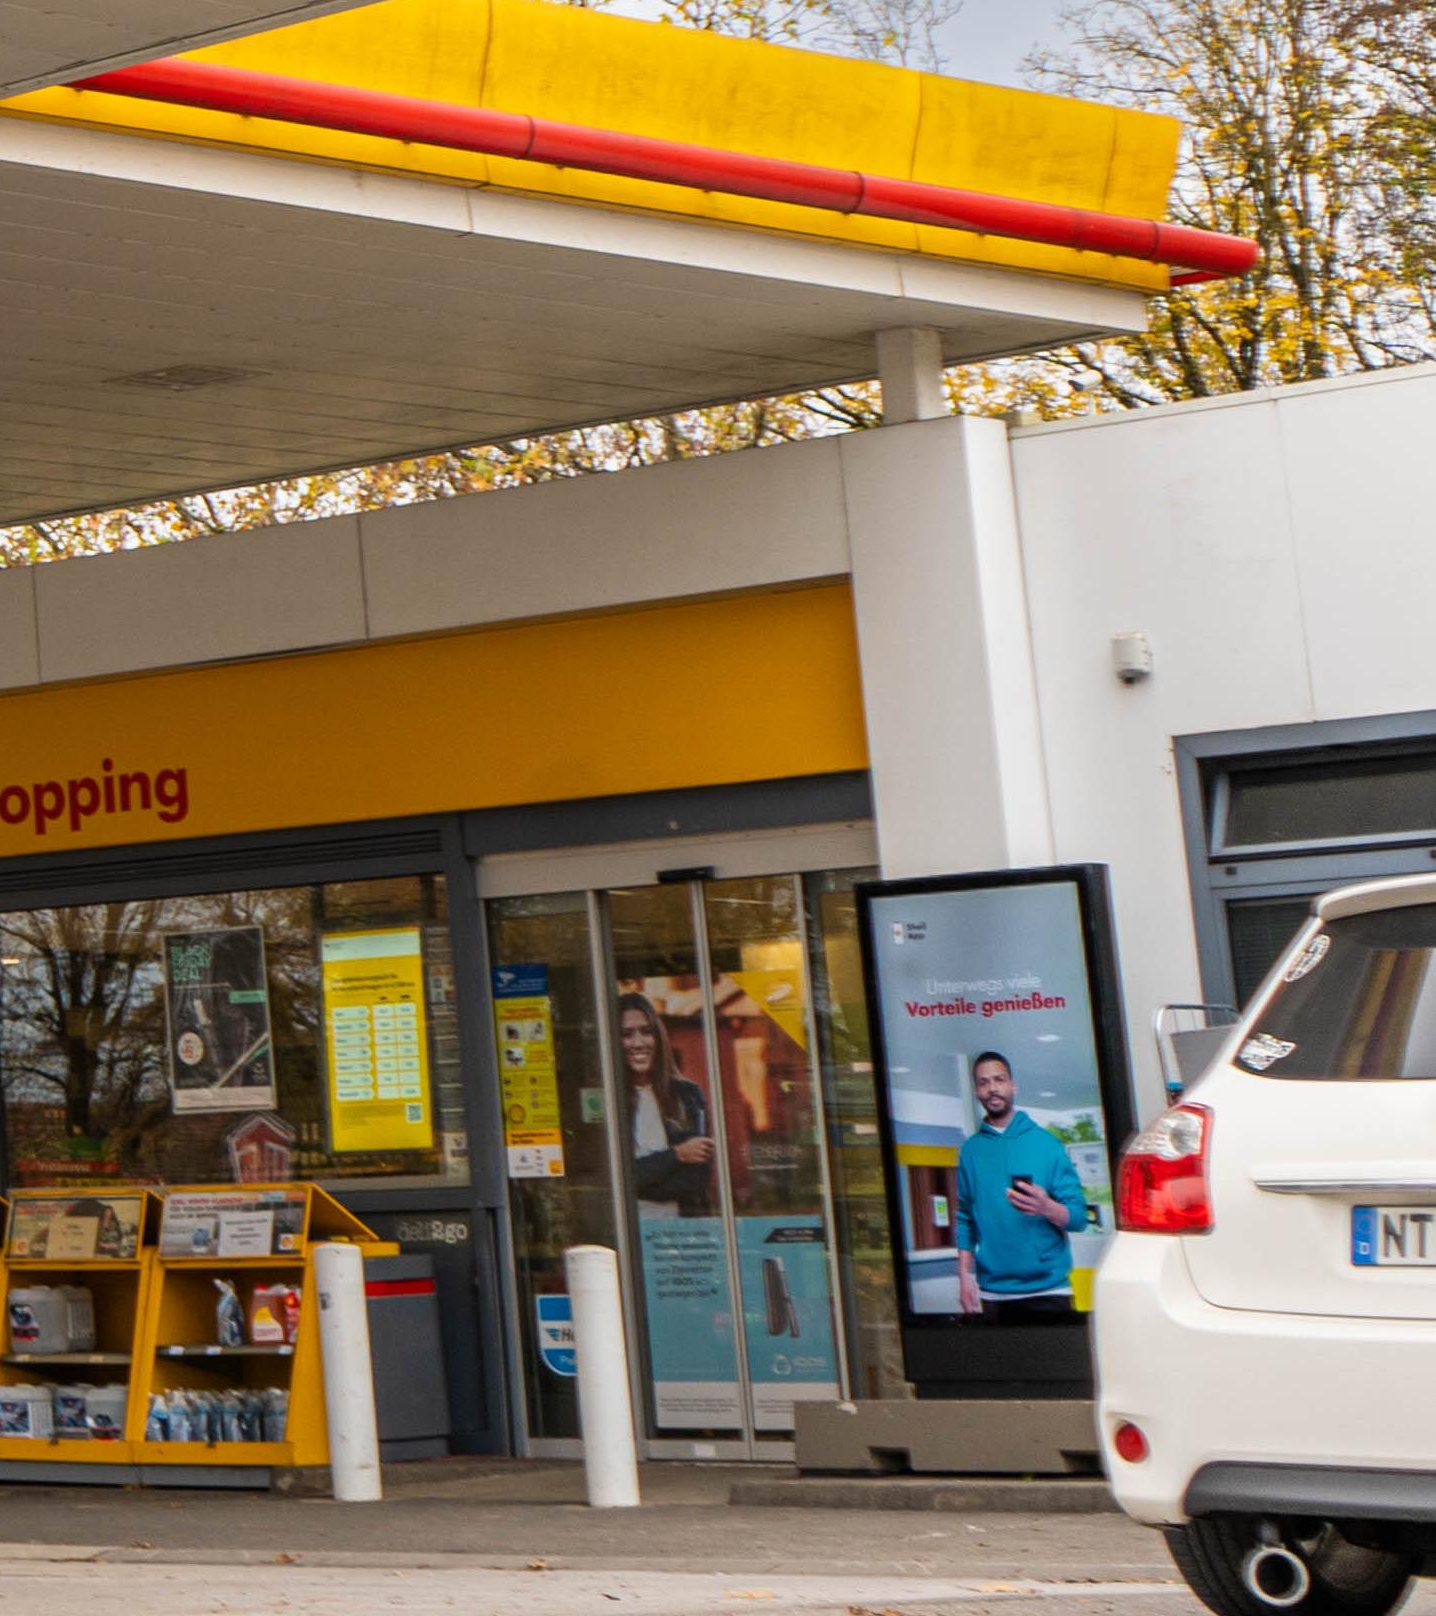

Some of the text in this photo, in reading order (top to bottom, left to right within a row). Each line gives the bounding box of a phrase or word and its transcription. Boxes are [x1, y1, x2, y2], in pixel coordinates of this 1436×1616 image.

[925, 970, 1042, 996] Unterwegs viele
[905, 991, 1067, 1018] Vorteile genießen
[1383, 1213, 1434, 1258] NT
